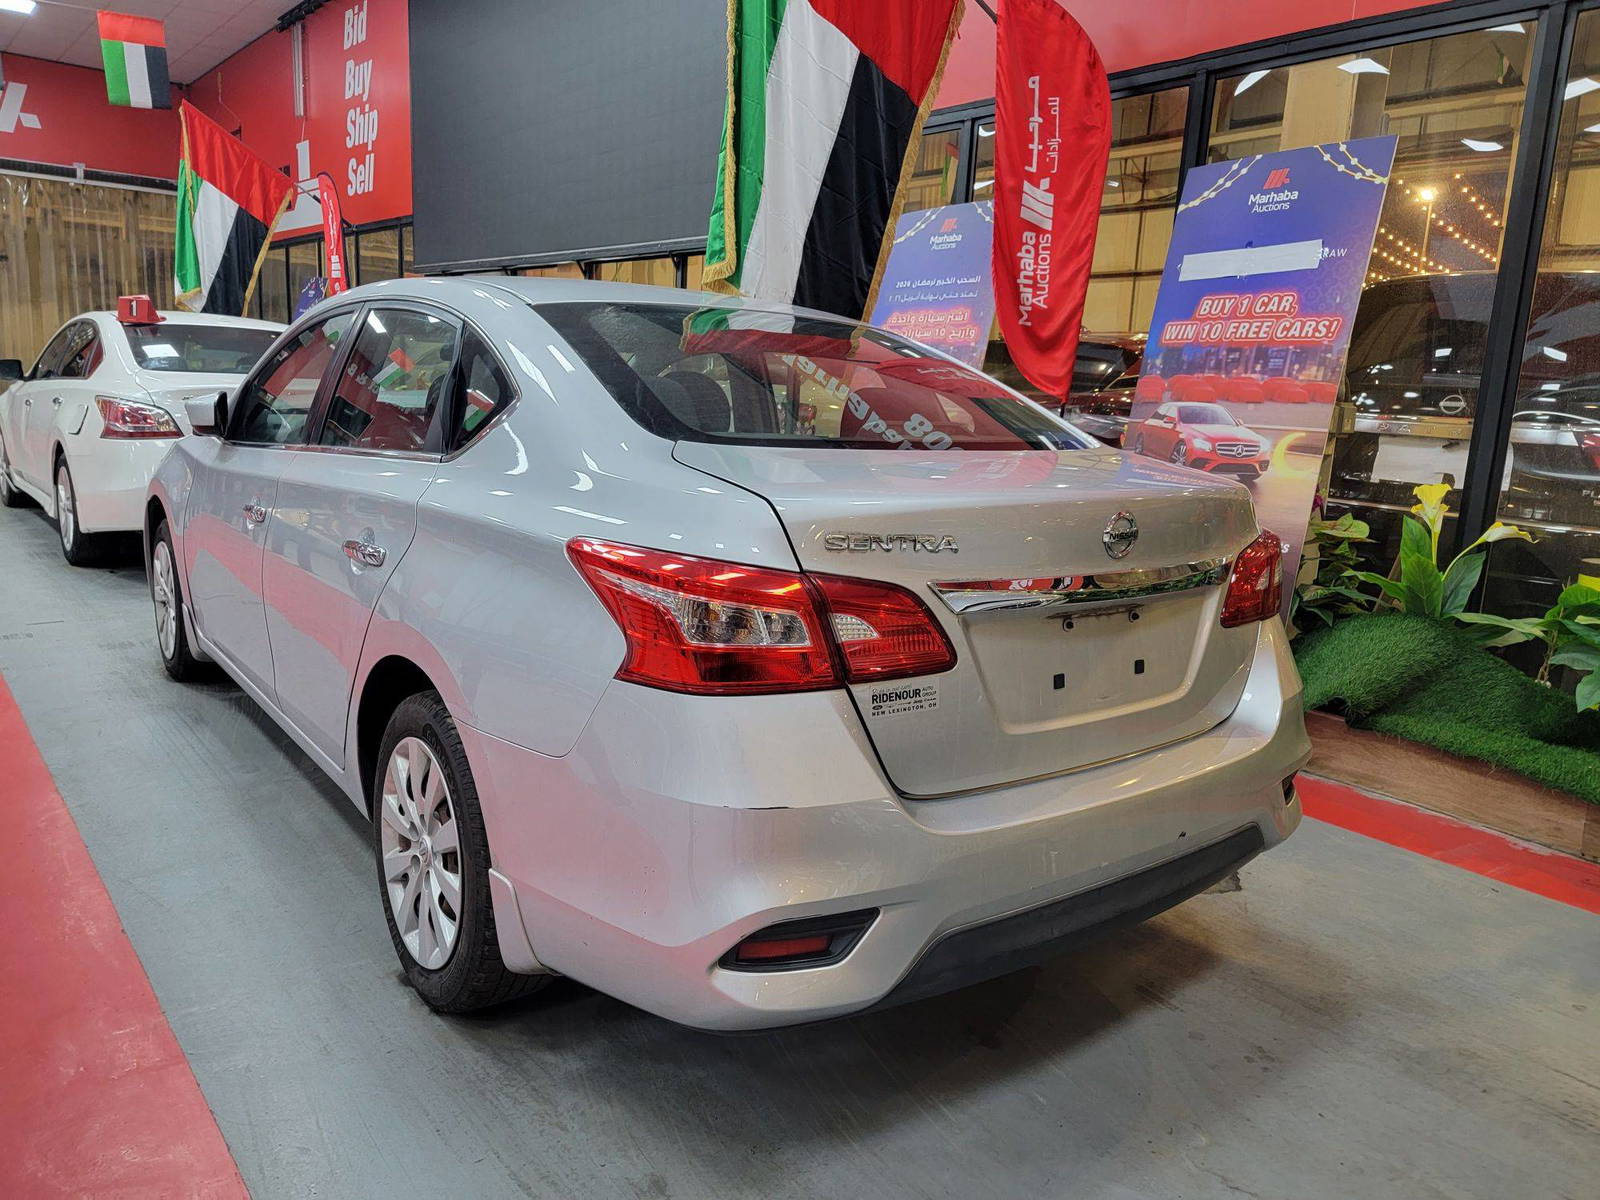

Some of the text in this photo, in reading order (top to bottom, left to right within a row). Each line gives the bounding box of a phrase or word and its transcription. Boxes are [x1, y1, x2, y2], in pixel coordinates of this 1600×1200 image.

[343, 0, 368, 50] Bid
[345, 59, 373, 102] Buy
[346, 104, 378, 151] Ship
[347, 153, 375, 197] Sell
[1248, 189, 1299, 205] Marhaba
[1251, 202, 1290, 214] Auctions
[1016, 231, 1037, 327] Marhaba
[1032, 233, 1052, 309] Auctions
[131, 300, 138, 317] 1
[1200, 293, 1299, 316] BUY 1 CAR,
[1164, 318, 1340, 340] WIN 10 FREE CARS!
[825, 534, 960, 553] SENTRA
[872, 688, 921, 705] RIDENOUR
